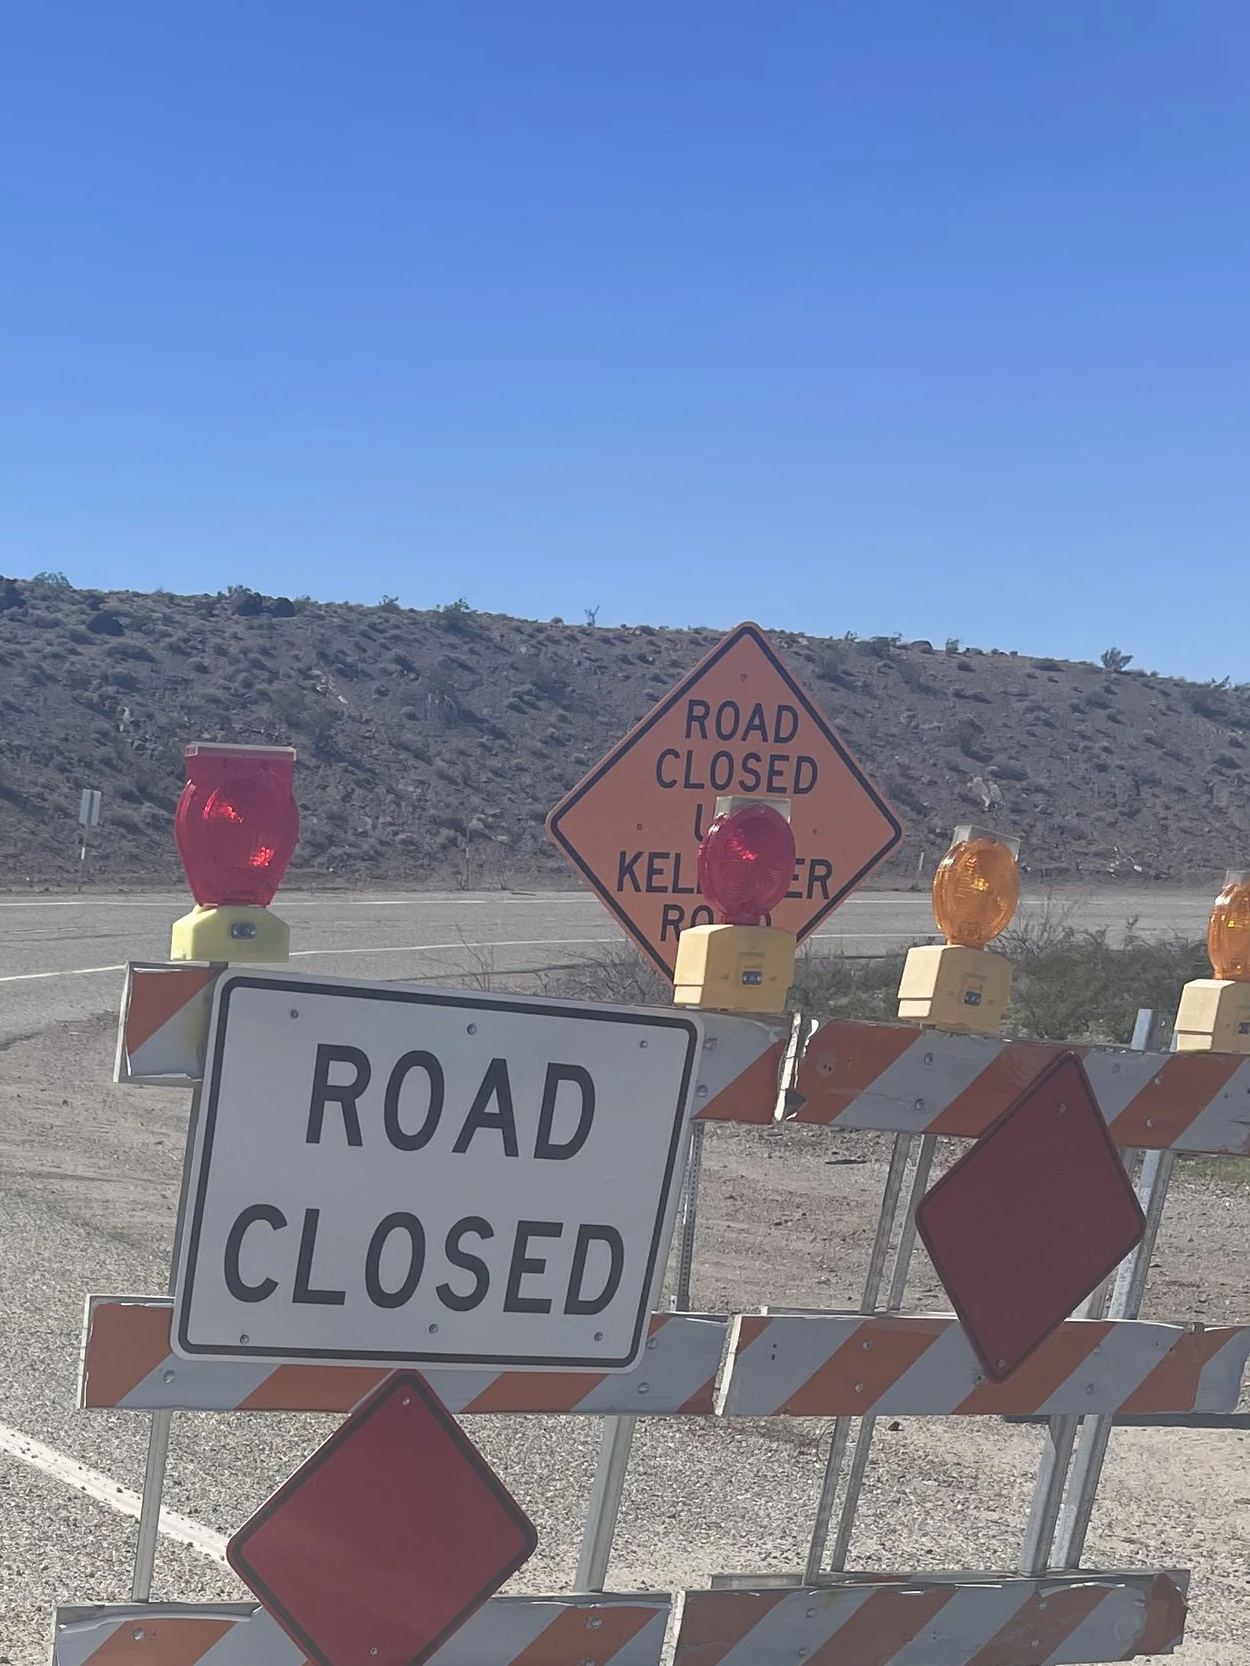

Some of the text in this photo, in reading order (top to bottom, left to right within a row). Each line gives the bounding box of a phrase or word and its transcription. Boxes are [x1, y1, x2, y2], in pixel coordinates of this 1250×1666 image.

[685, 700, 799, 743] ROAD
[656, 748, 818, 795] CLOSED
[617, 851, 833, 900] KELER
[306, 1044, 596, 1161] ROAD
[224, 1204, 625, 1316] CLOSED
